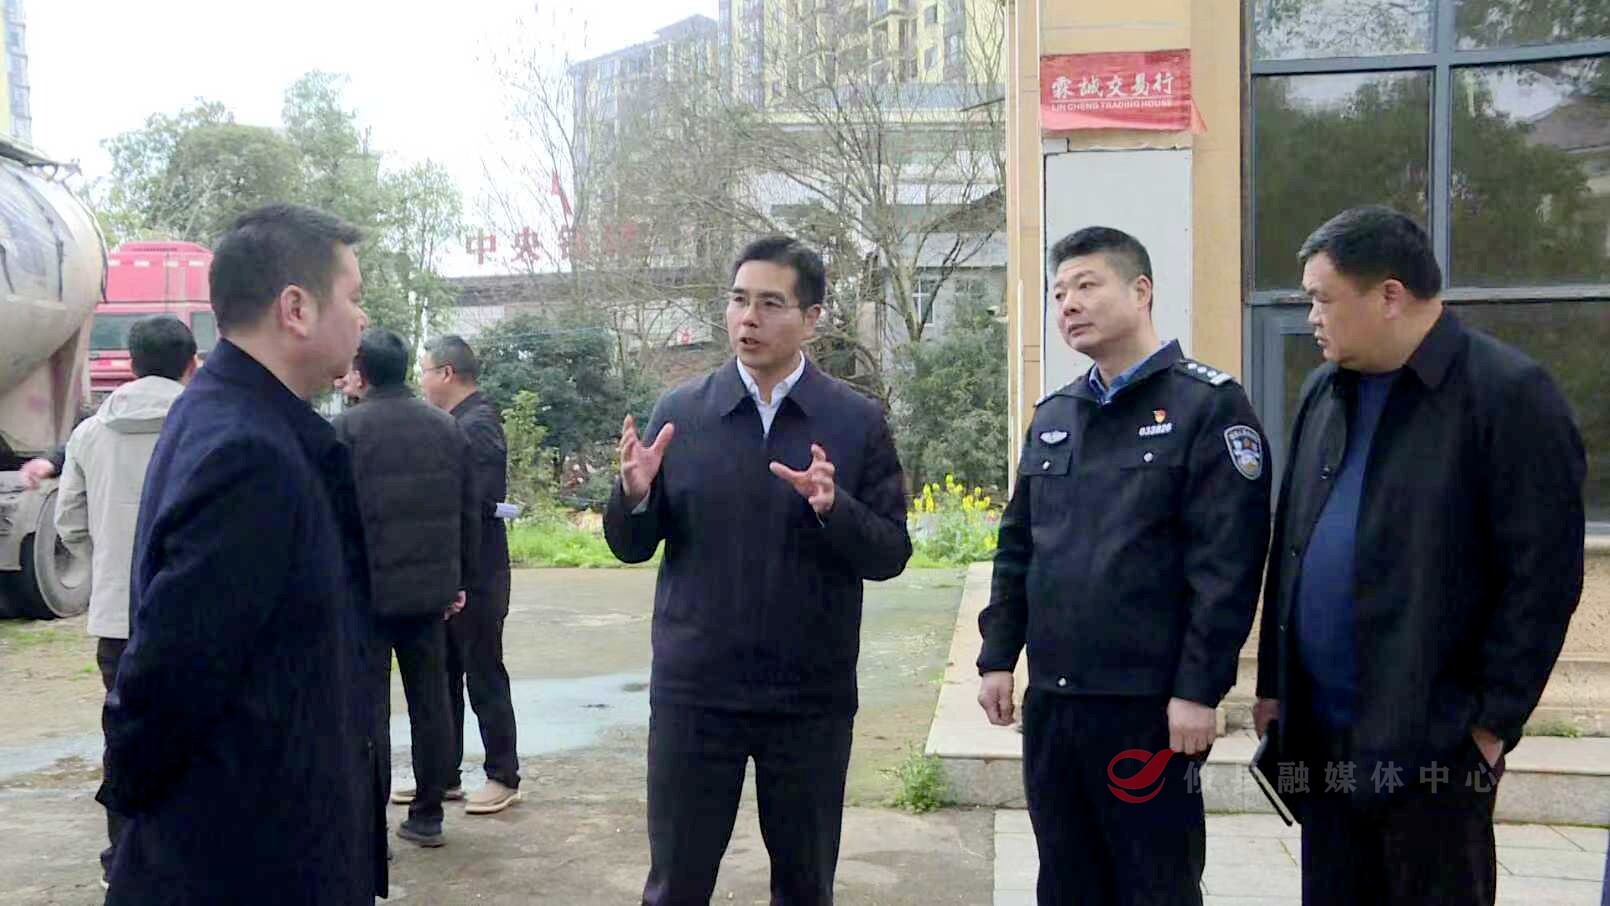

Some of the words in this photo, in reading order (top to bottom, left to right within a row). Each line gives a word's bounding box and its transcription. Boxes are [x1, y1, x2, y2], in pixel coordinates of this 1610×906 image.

[1051, 102, 1066, 112] LIN
[1067, 101, 1099, 112] CHENG
[1101, 99, 1139, 110] TRADING
[1141, 98, 1172, 108] HOUSE
